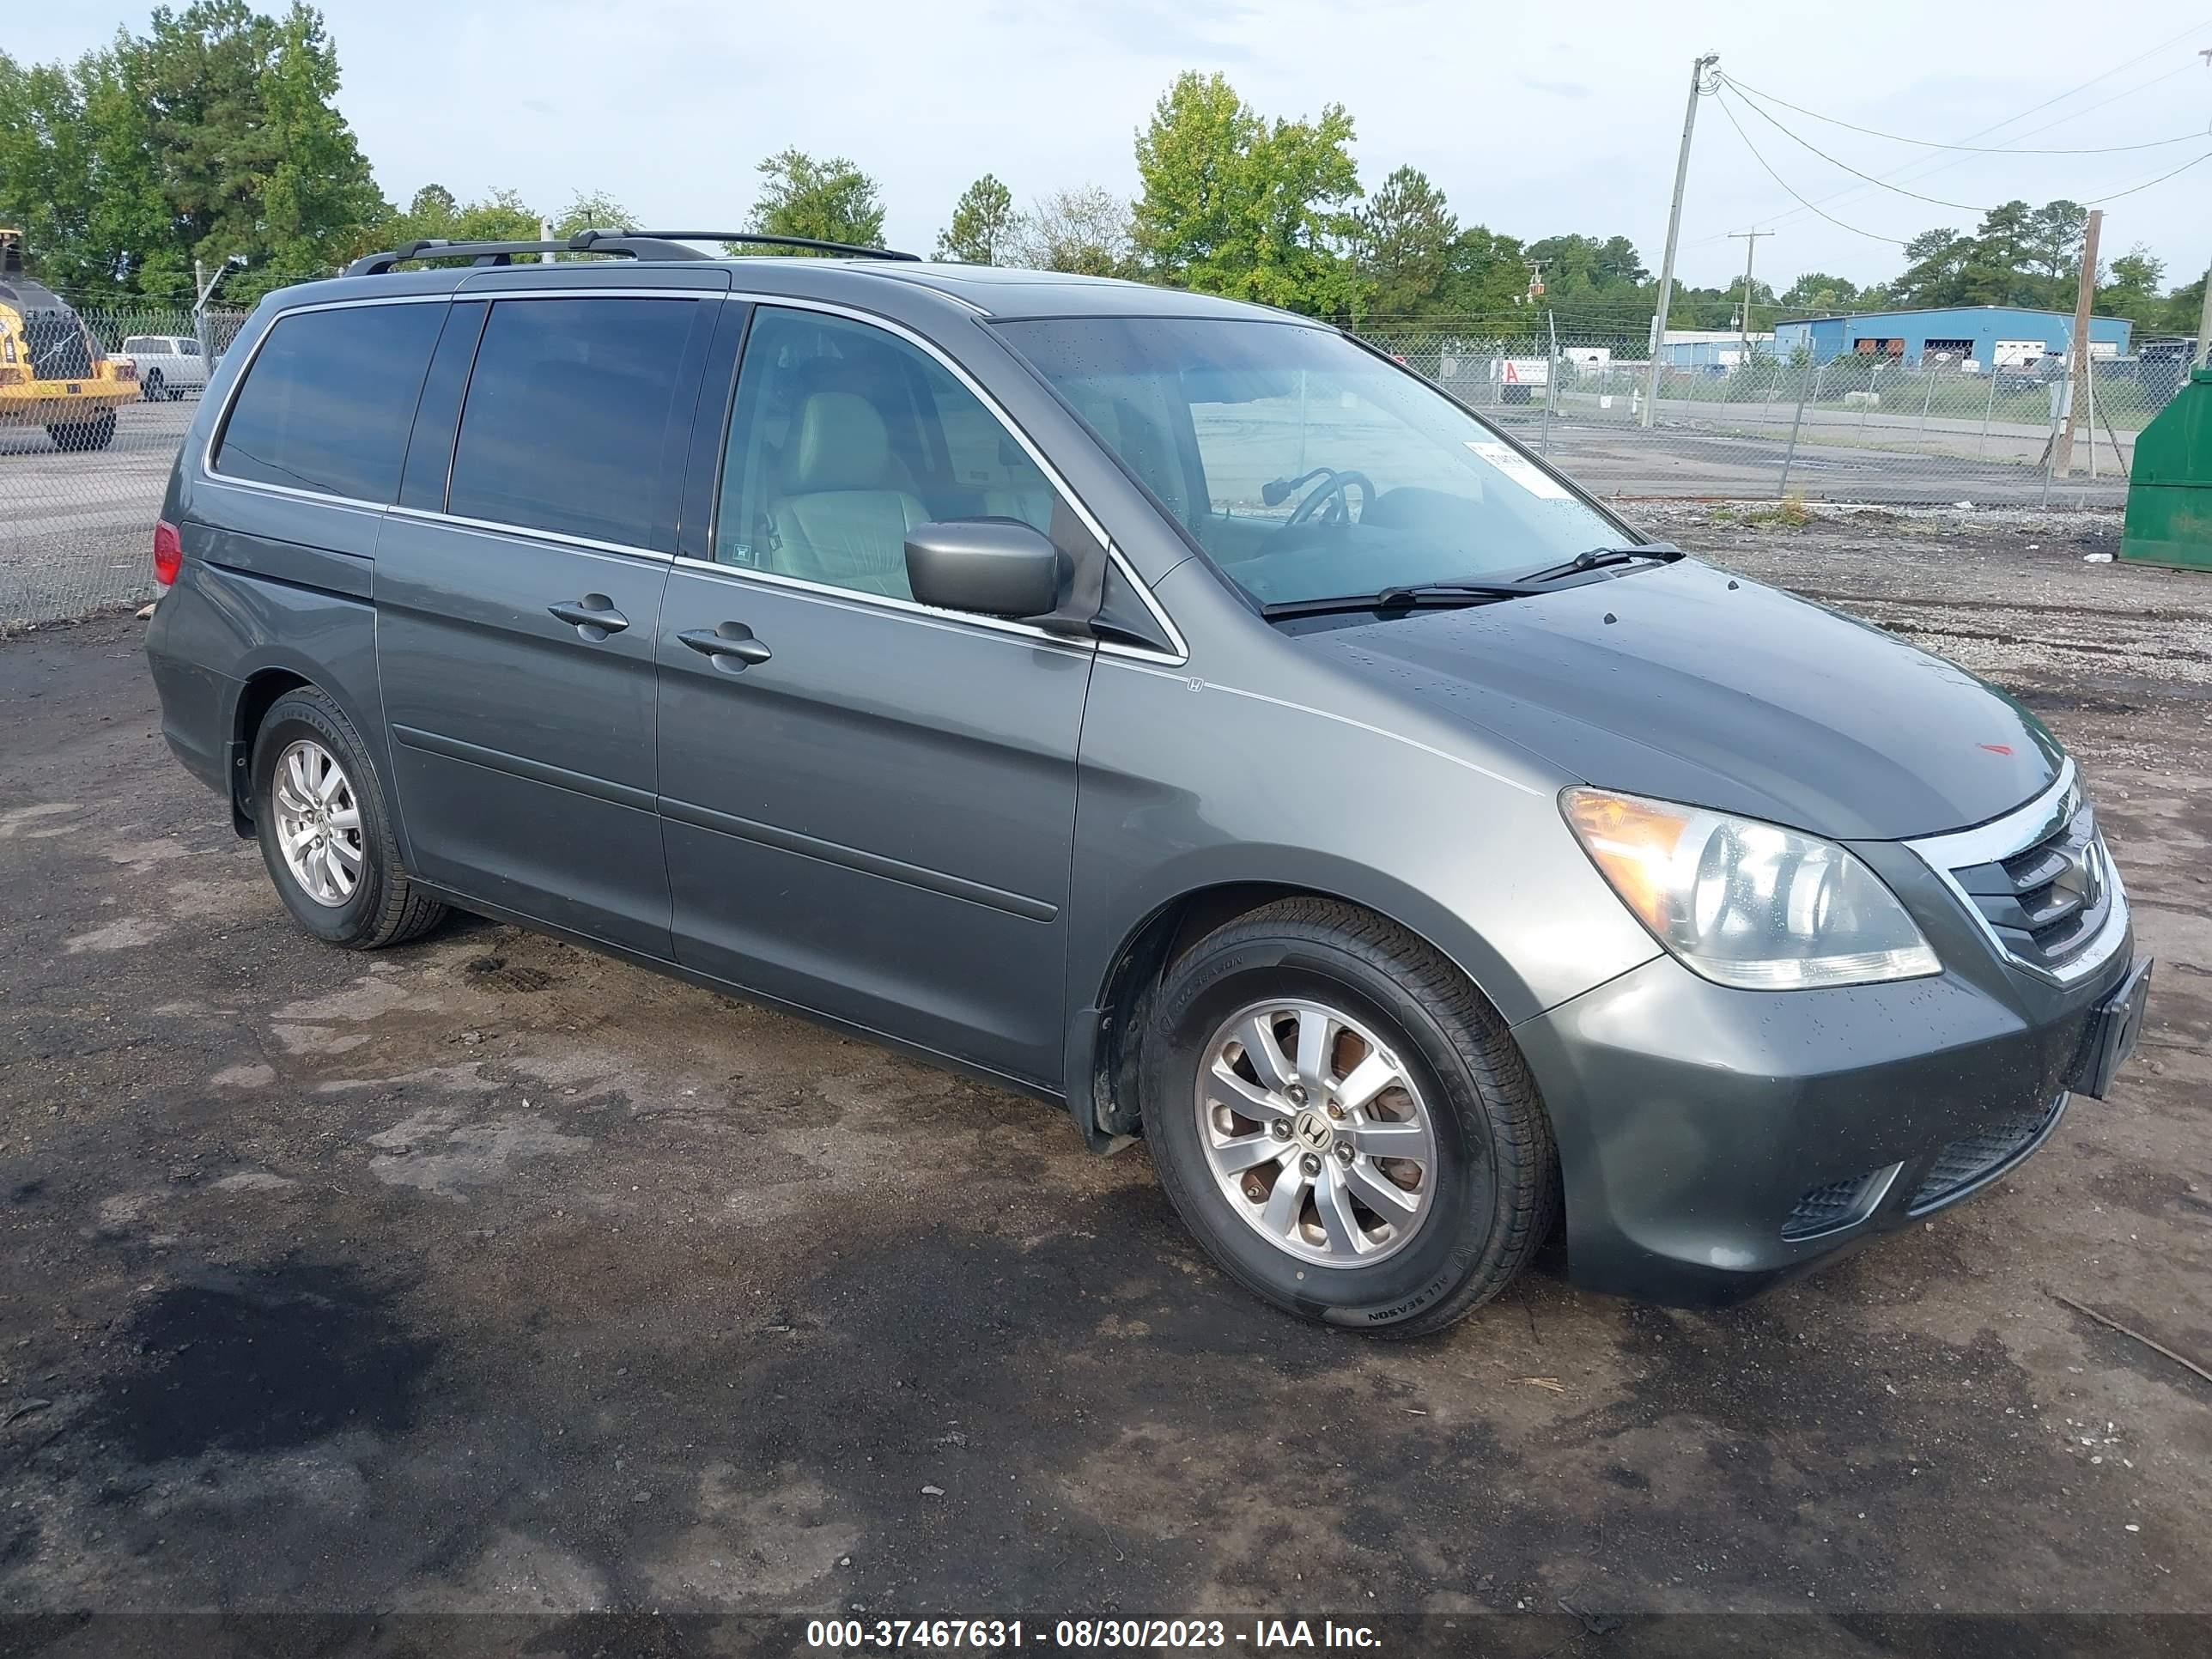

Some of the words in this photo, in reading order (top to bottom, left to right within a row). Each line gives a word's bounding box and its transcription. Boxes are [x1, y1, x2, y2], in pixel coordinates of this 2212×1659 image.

[1506, 362, 1519, 384] A
[1425, 1277, 1449, 1297] ALL
[1367, 1295, 1426, 1322] SEASON
